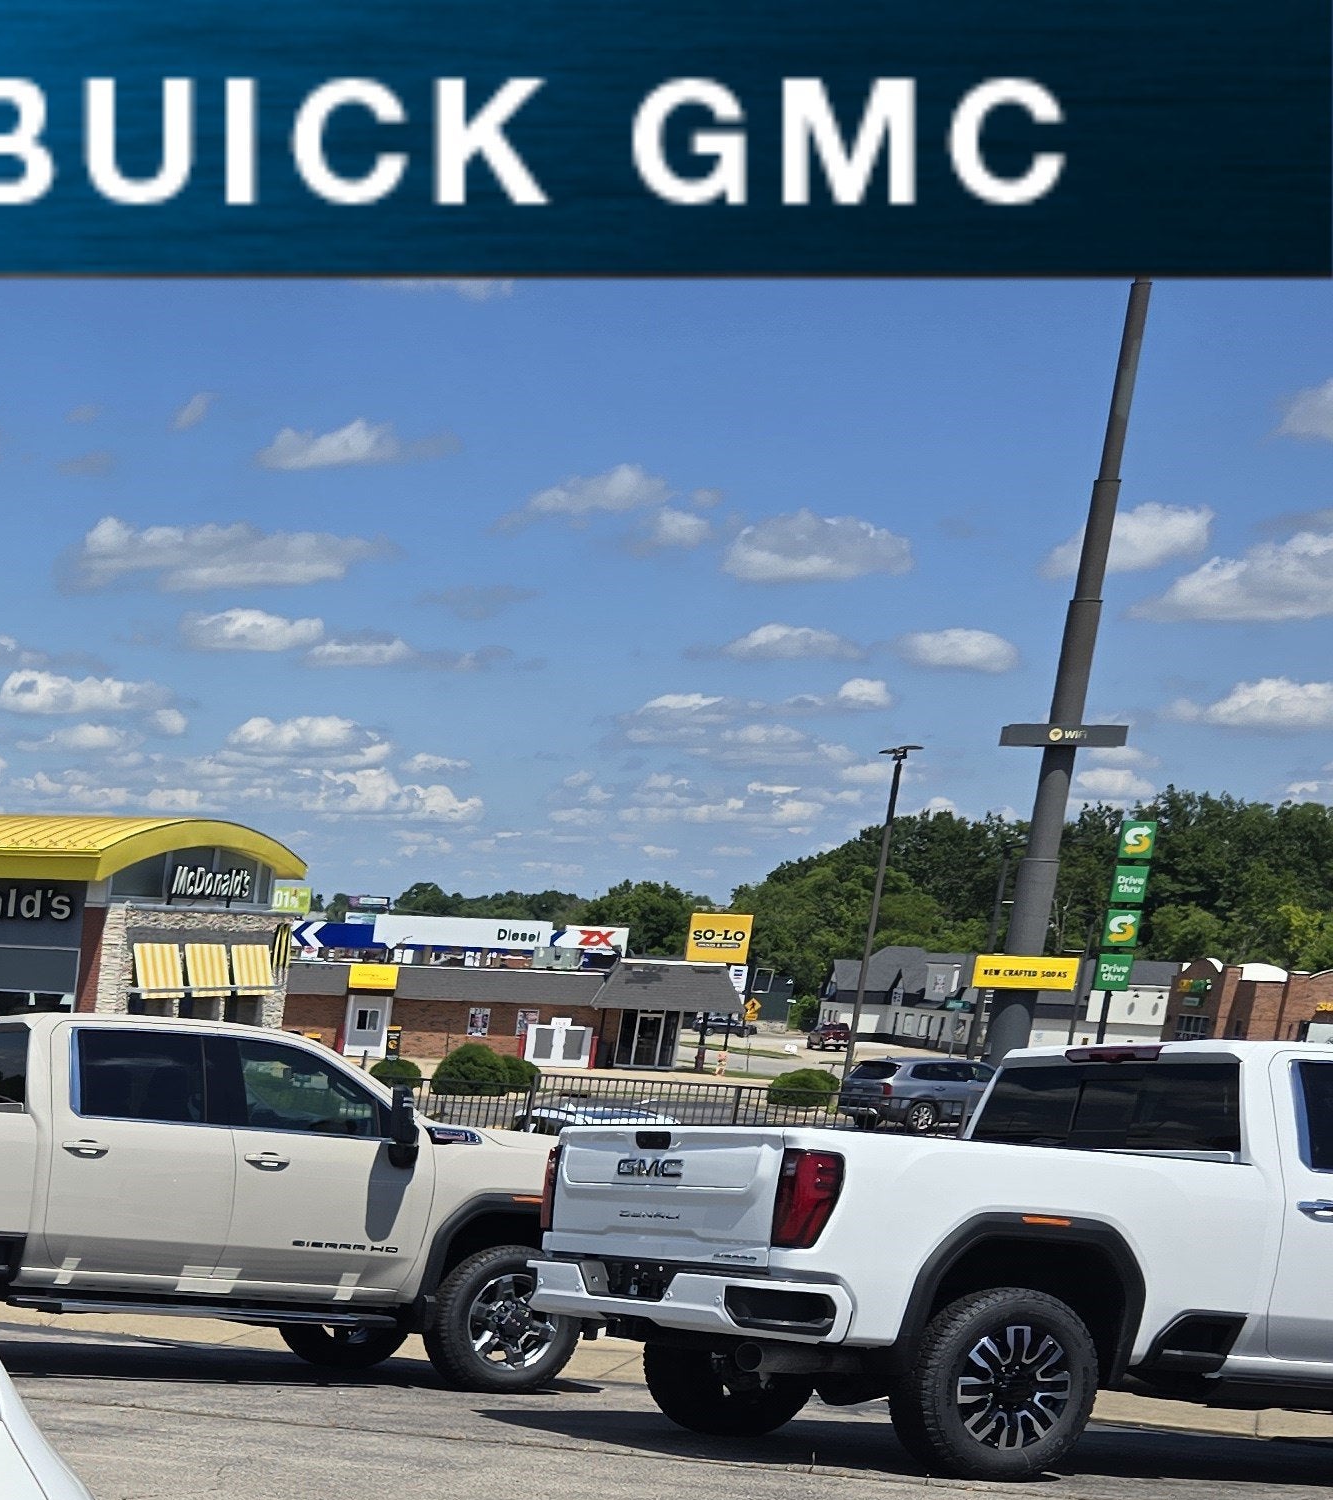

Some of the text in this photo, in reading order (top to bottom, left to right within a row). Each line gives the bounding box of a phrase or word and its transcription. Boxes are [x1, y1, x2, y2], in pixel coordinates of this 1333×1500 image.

[171, 865, 251, 898] McDonald's
[1117, 875, 1145, 885] Drive
[1118, 884, 1141, 894] thru
[497, 928, 541, 943] Diesel
[578, 929, 617, 947] ZX
[693, 929, 745, 941] SO-LO
[1003, 969, 1037, 977] CRAFTED
[1100, 963, 1129, 973] Drive
[1102, 972, 1125, 982] thru
[617, 1158, 684, 1178] GMC
[619, 1210, 680, 1220] DENALI
[292, 1240, 399, 1253] SIERRA HD
